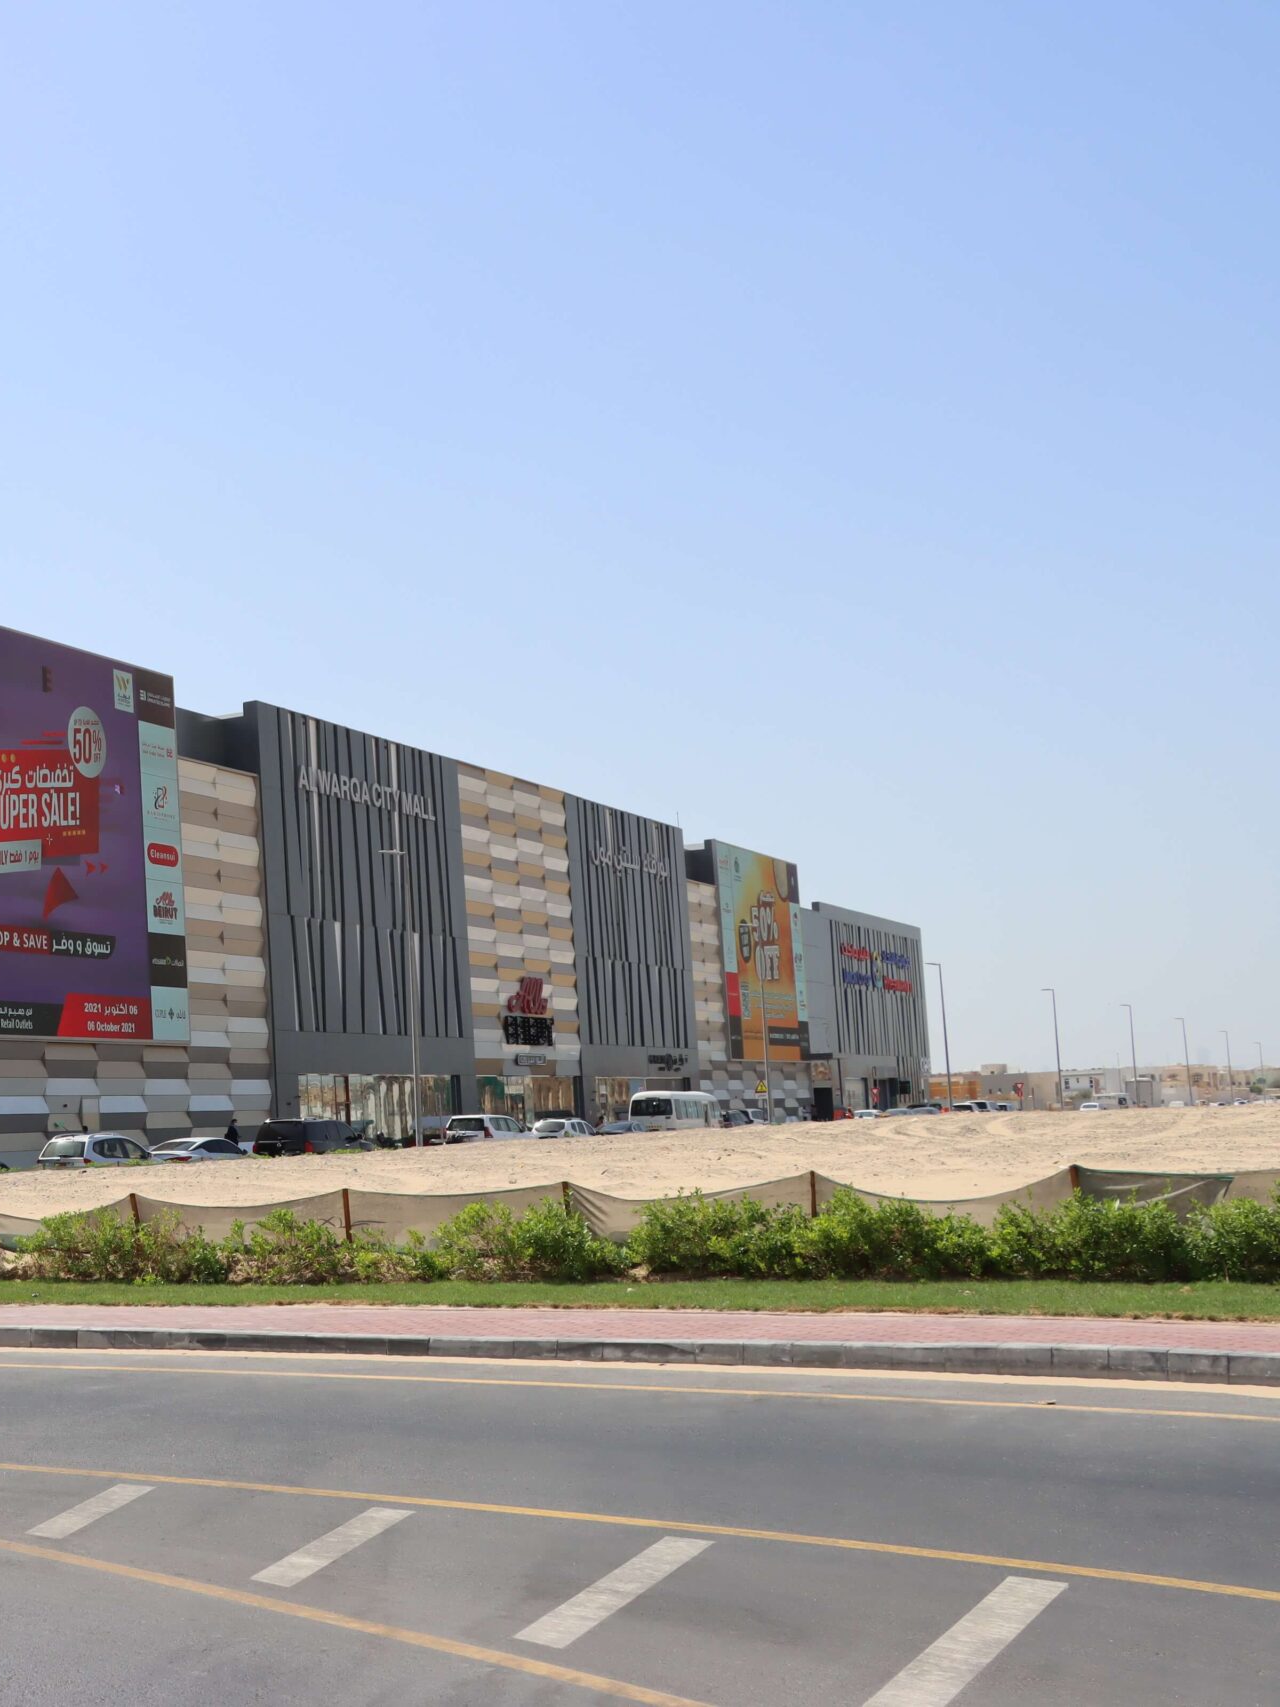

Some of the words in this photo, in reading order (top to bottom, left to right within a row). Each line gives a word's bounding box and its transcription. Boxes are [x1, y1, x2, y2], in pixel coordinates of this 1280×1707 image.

[73, 727, 102, 764] 50%
[25, 763, 74, 794] تخفيضات
[297, 764, 319, 793] AL
[318, 768, 371, 806] WARQA
[372, 783, 400, 813] CITY
[401, 791, 436, 821] MALL
[41, 791, 81, 828] SALE!
[751, 906, 779, 942] 50%
[12, 930, 21, 948] &
[22, 931, 48, 950] SAVE
[84, 1002, 102, 1013] 2021
[1, 1018, 15, 1029] Retail
[15, 1019, 33, 1030] Outlets
[87, 1021, 96, 1032] 06
[96, 1021, 120, 1033] October
[121, 1022, 136, 1033] 2021
